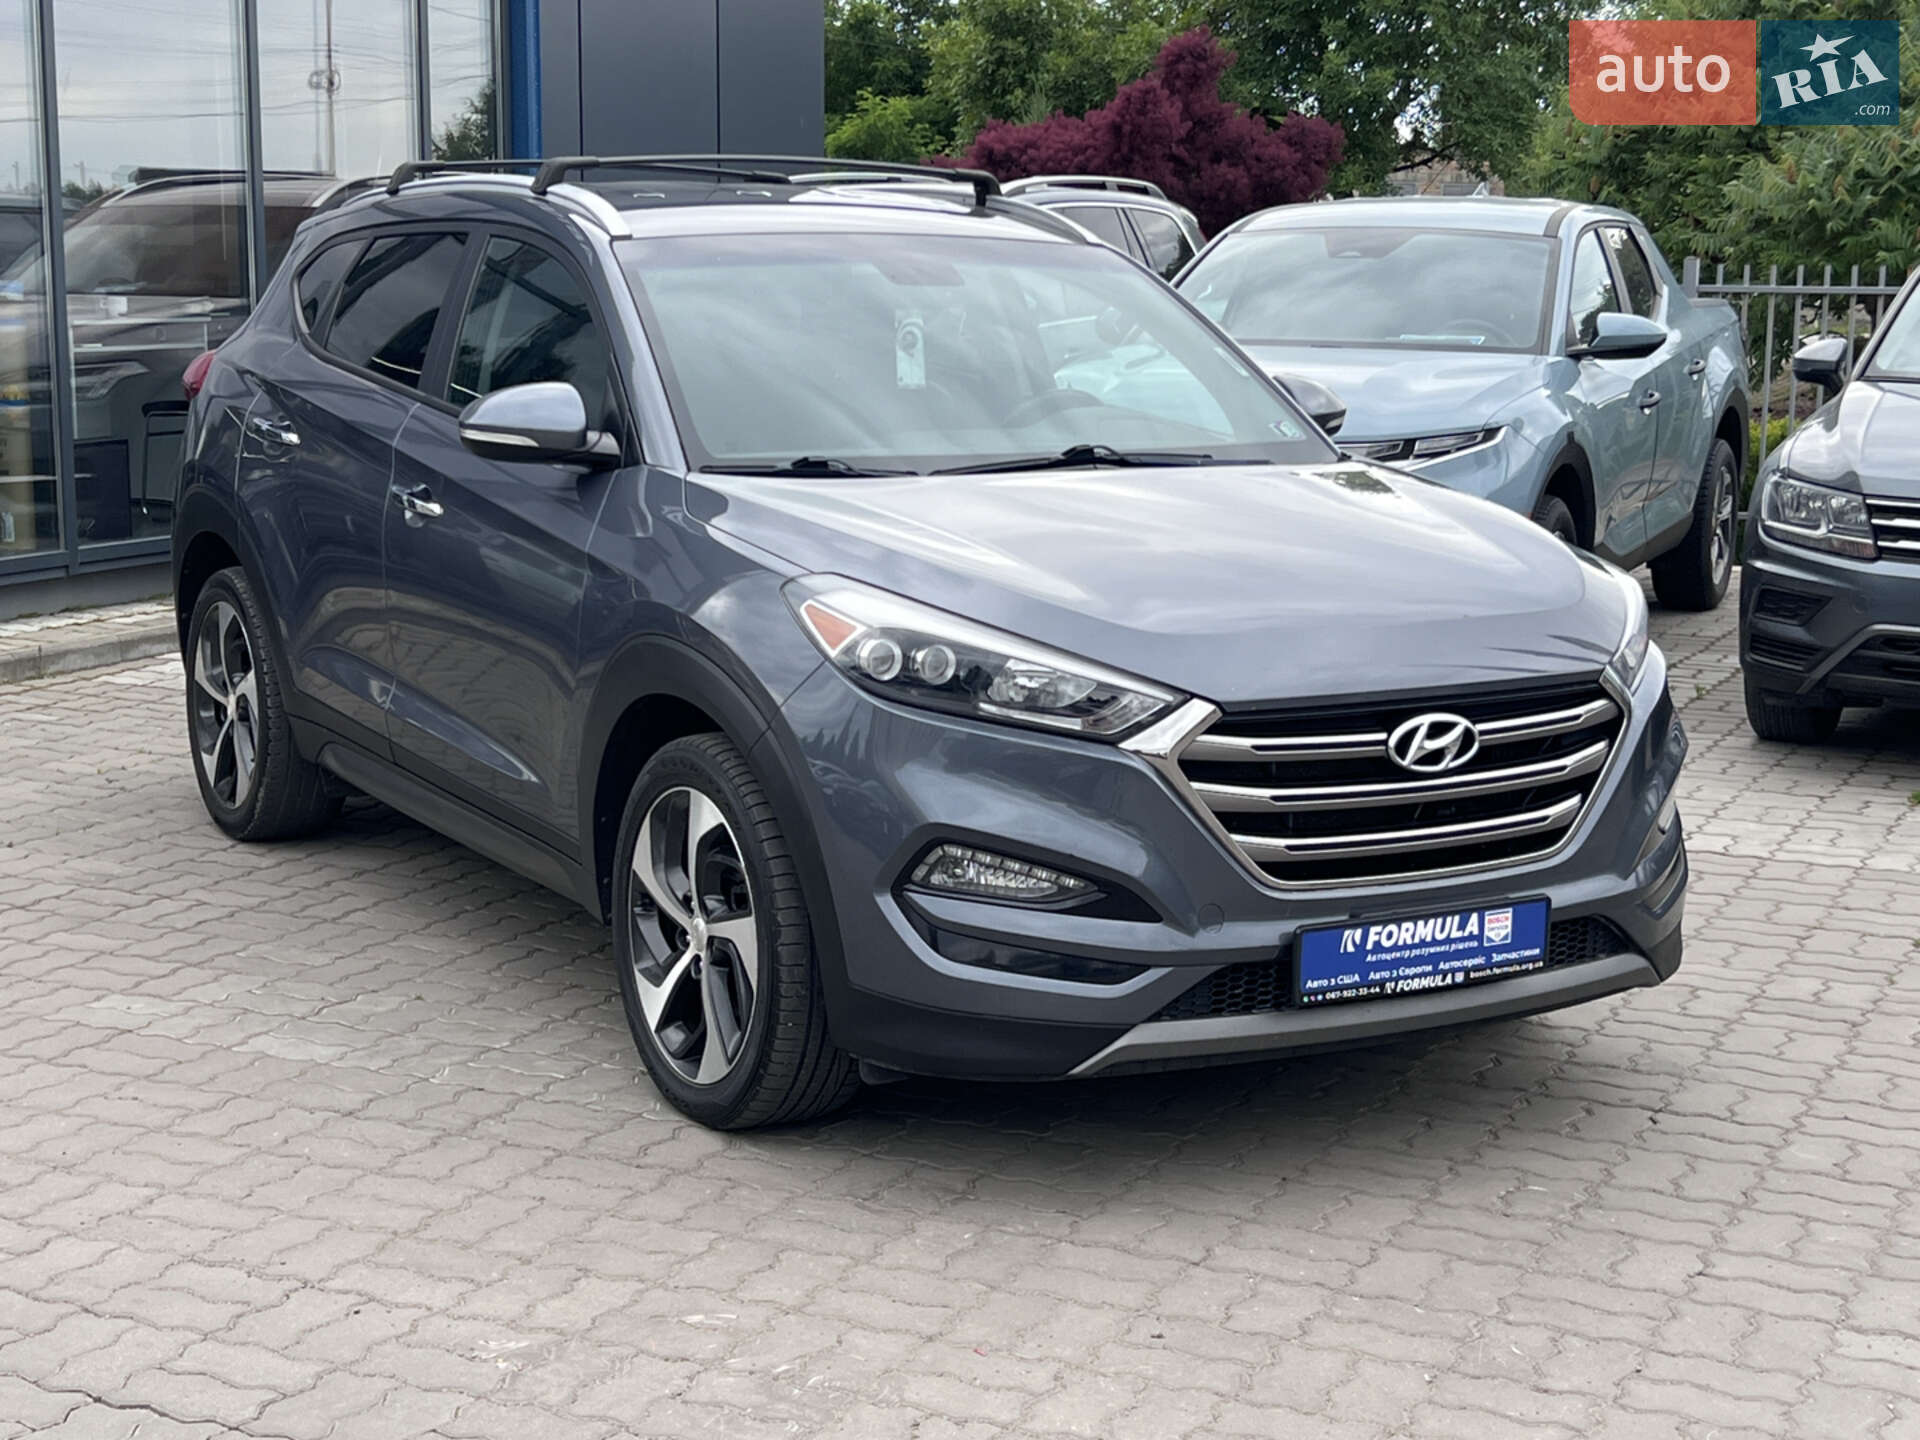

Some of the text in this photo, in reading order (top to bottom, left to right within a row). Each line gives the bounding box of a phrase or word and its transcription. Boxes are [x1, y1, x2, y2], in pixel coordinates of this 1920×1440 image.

[1365, 912, 1479, 951] FORMULA
[1305, 978, 1329, 989] Авто
[1336, 973, 1360, 985] США
[1368, 969, 1391, 981] Авто
[1396, 973, 1452, 993] FORMULA
